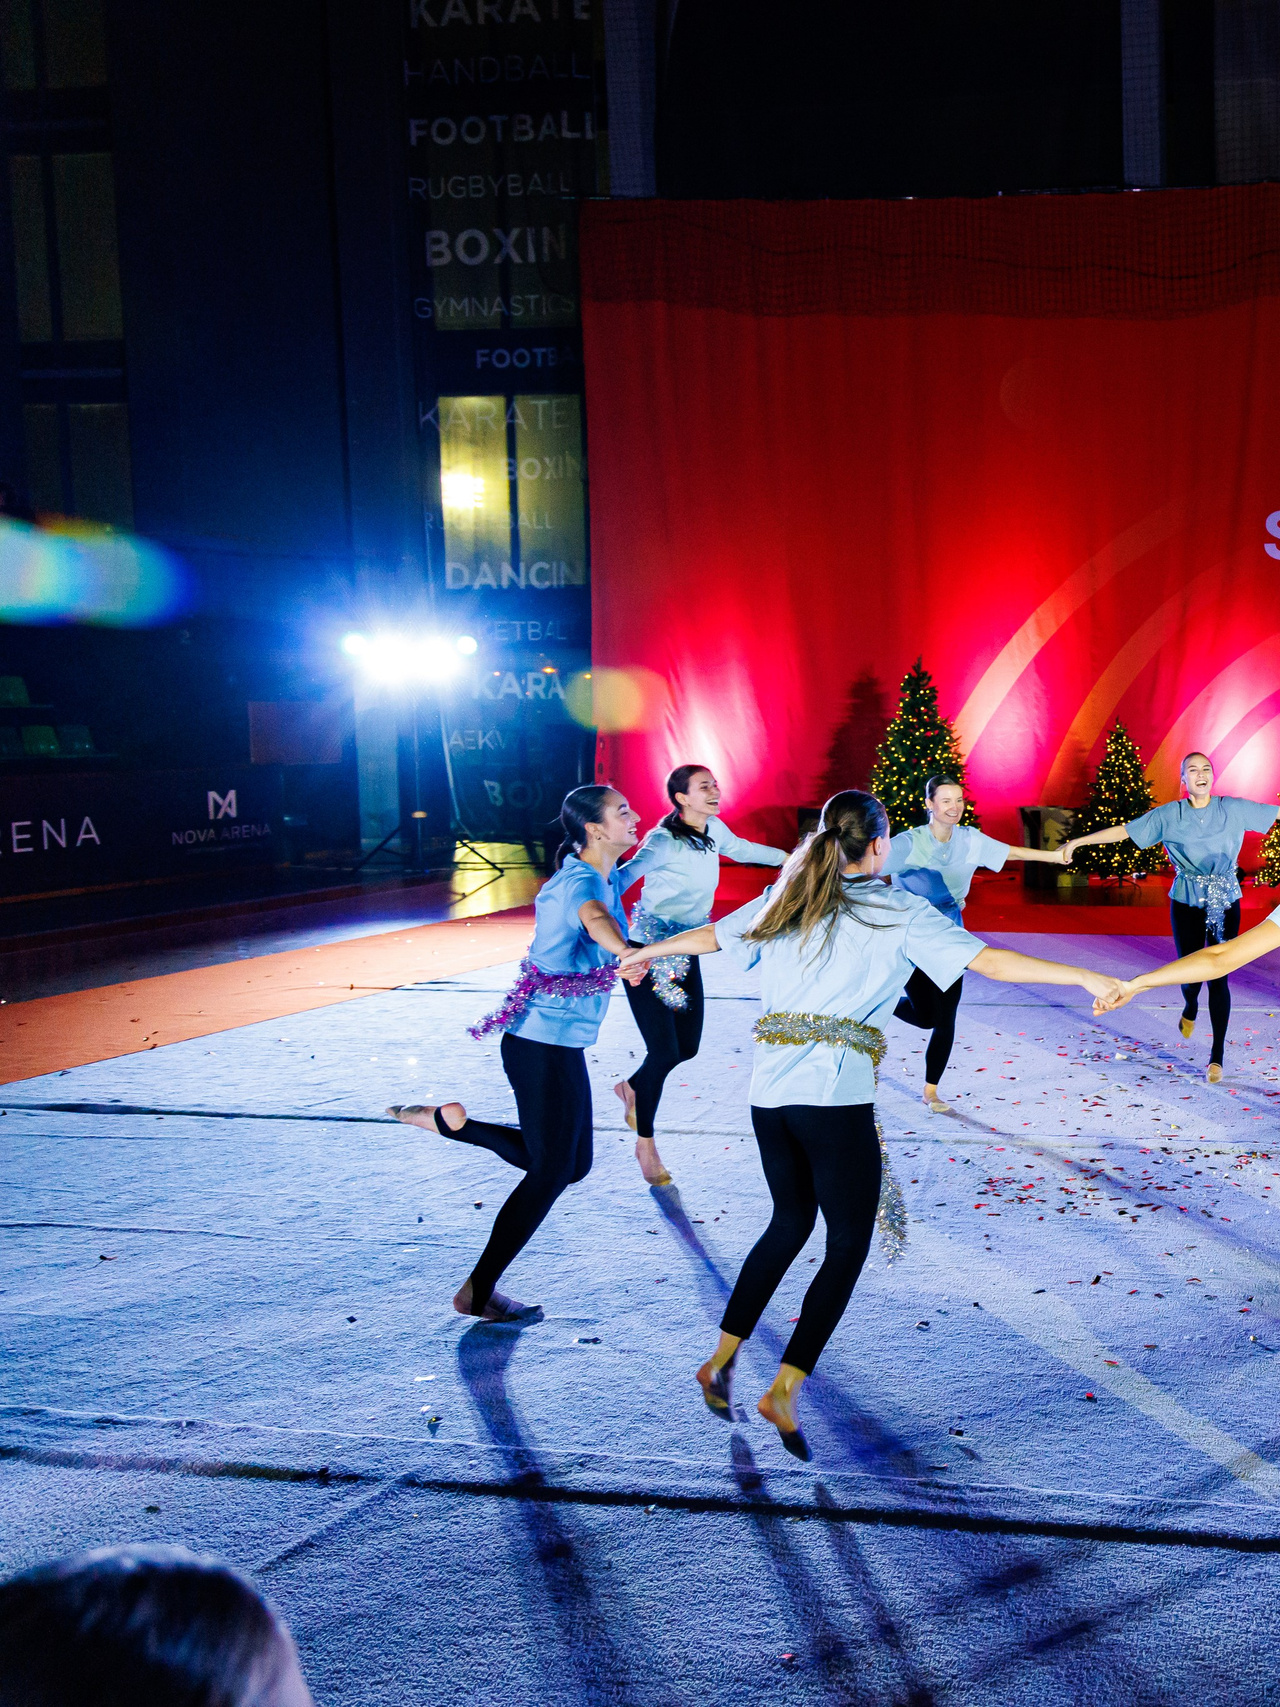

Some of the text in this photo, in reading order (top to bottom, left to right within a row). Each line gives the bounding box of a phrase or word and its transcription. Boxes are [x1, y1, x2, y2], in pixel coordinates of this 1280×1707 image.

[403, 52, 591, 87] HANDBALL
[418, 397, 569, 432] KARATE
[0, 816, 101, 853] ENA
[171, 823, 272, 846] NOVA ARENA
